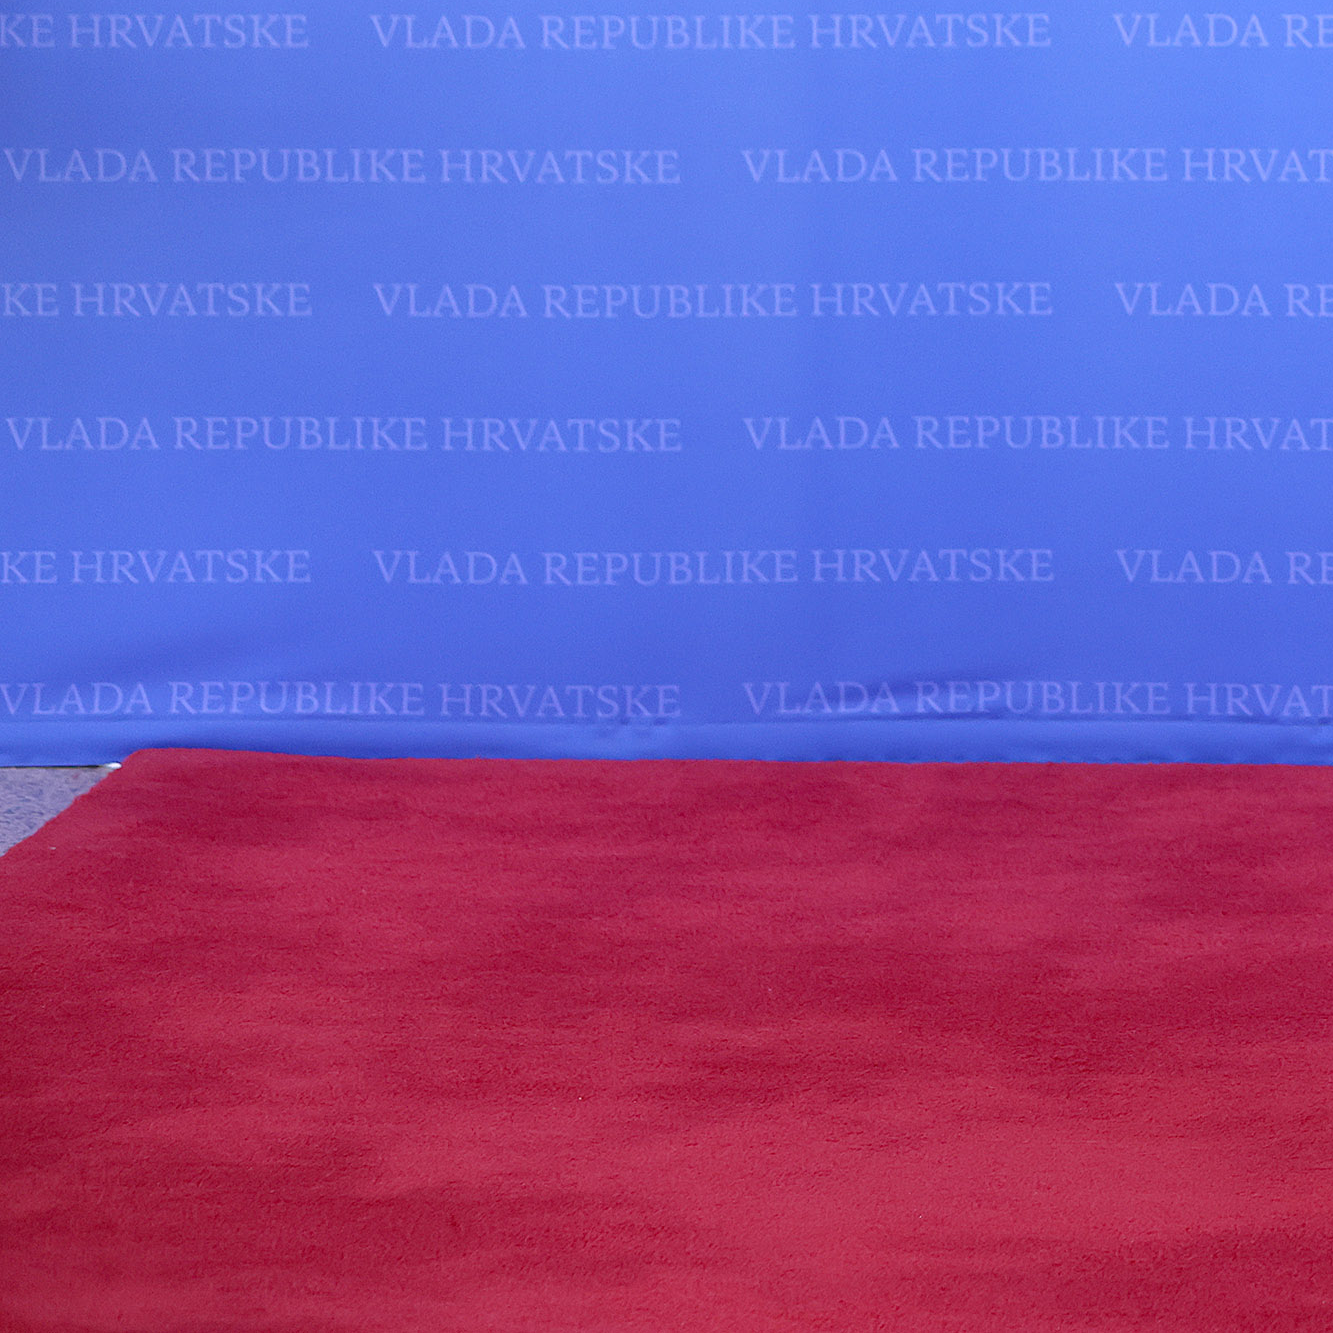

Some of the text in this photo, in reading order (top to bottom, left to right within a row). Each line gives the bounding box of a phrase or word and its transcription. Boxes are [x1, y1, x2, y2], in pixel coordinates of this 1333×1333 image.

[67, 14, 310, 49] HRVATSKE
[369, 13, 1052, 50] VLADA REPUBLIKE HRVATSKE
[1112, 13, 1271, 48] VLADA
[3, 148, 681, 184] VLADA REPUBLIKE HRVATSKE
[740, 148, 899, 183] VLADA
[911, 147, 1169, 182] REPUBLIKE
[70, 282, 313, 317] HRVATSKE
[372, 281, 1054, 319] VLADA REPUBLIKE HRVATSKE
[1113, 281, 1272, 317] VLADA
[4, 416, 683, 453] VLADA REPUBLIKE HRVATSKE
[742, 416, 901, 451] VLADA
[912, 415, 1171, 450] REPUBLIKE
[70, 549, 312, 584] HRVATSKE
[371, 548, 1055, 586] VLADA REPUBLIKE HRVATSKE
[1114, 549, 1274, 584] VLADA
[0, 681, 683, 718] VLADA REPUBLIKE HRVATSKE
[742, 681, 901, 716] VLADA
[911, 680, 1171, 714] REPUBLIKE
